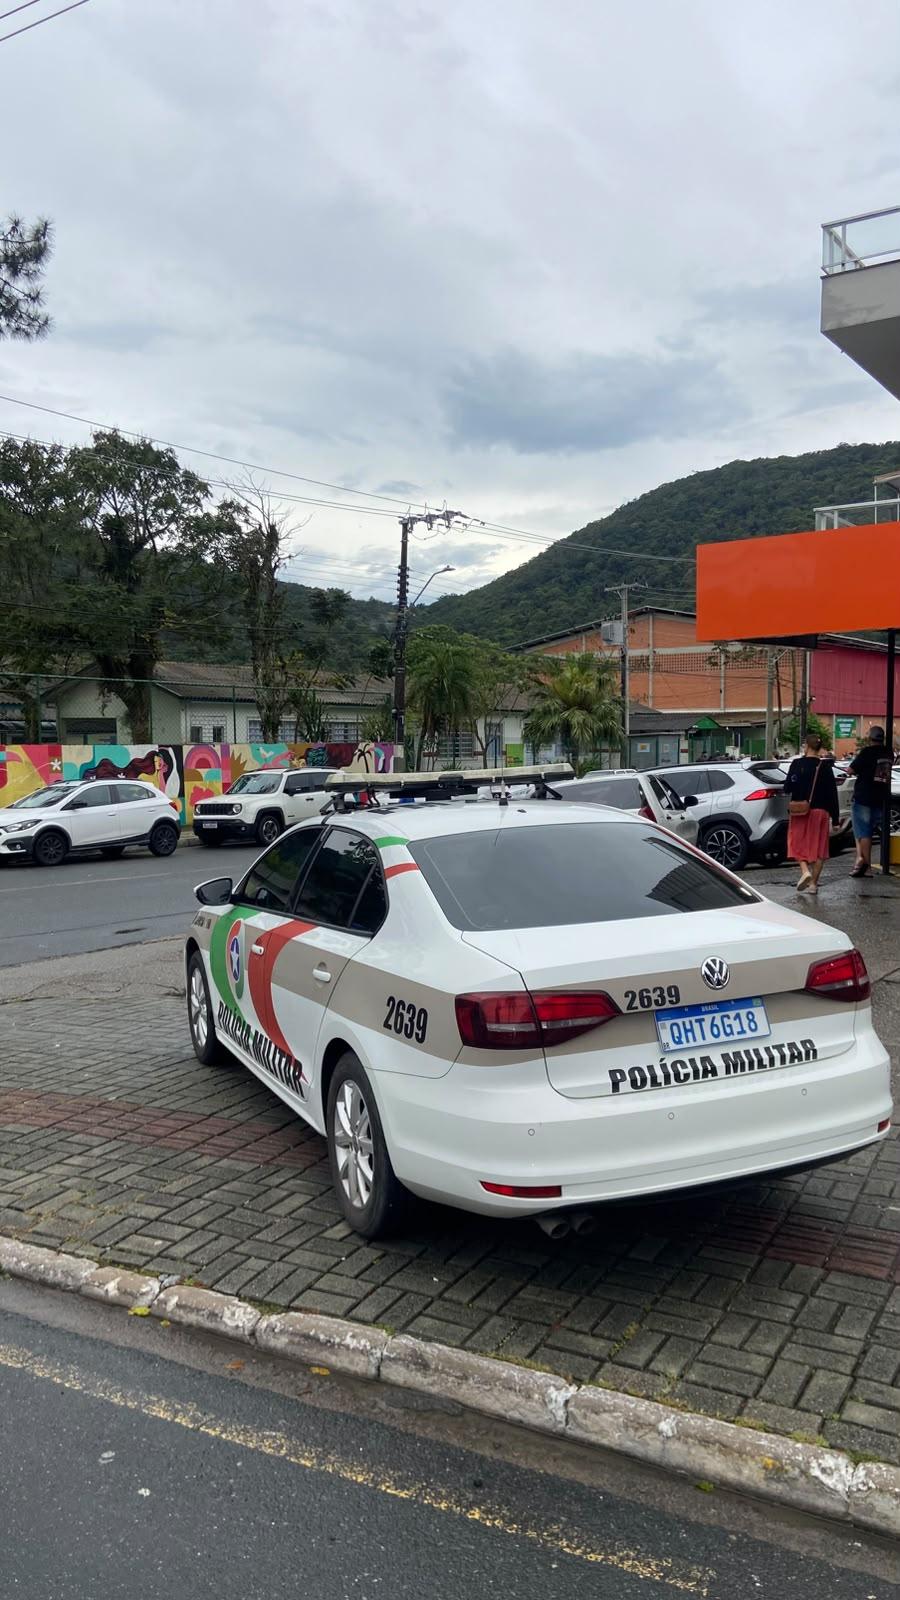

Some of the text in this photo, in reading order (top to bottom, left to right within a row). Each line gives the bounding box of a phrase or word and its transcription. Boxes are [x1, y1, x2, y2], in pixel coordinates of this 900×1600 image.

[624, 985, 681, 1011] 2639
[701, 1004, 720, 1012] BRASIL
[383, 995, 428, 1044] 2639
[669, 1010, 759, 1046] QHT6G18
[218, 1000, 305, 1099] POLÍCIA MILITAR
[608, 1038, 818, 1093] POLÍCIA MILITAR
